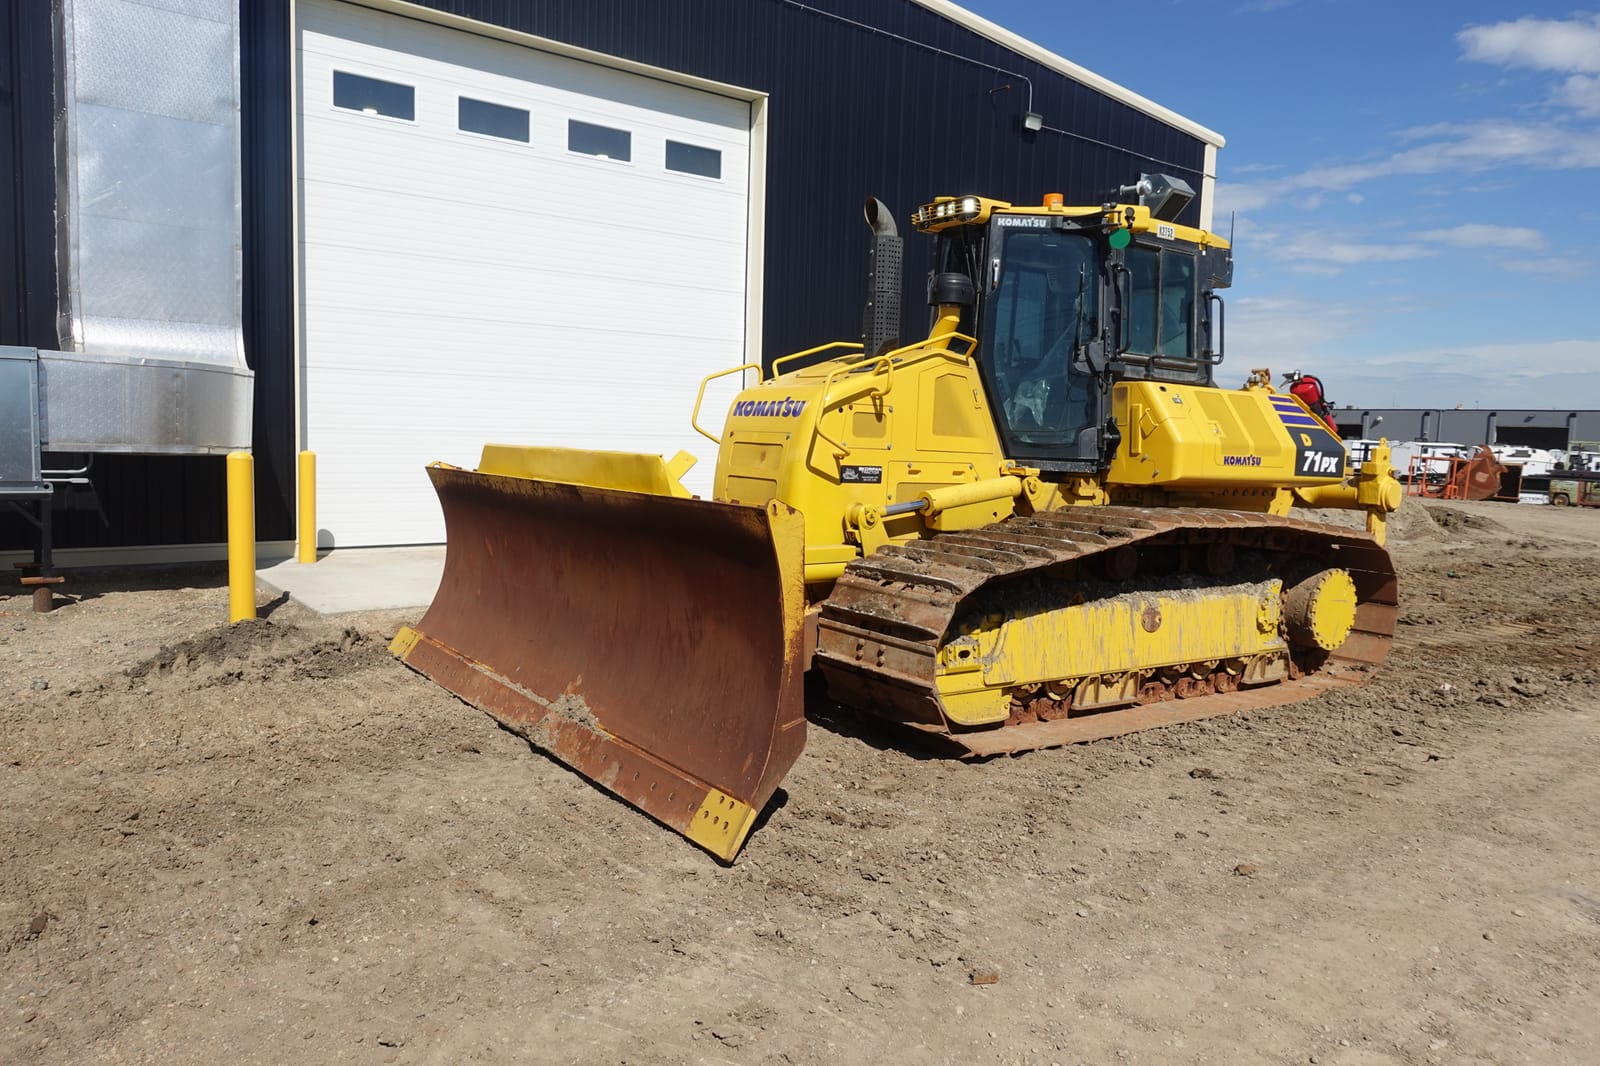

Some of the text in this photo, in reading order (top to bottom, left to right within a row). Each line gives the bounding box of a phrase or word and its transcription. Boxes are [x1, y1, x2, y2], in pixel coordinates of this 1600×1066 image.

[997, 217, 1047, 228] KOMATSU
[732, 396, 807, 418] KOMATSU
[1300, 433, 1313, 447] D
[1223, 454, 1262, 466] KOMATSU
[1302, 450, 1339, 473] 71PX
